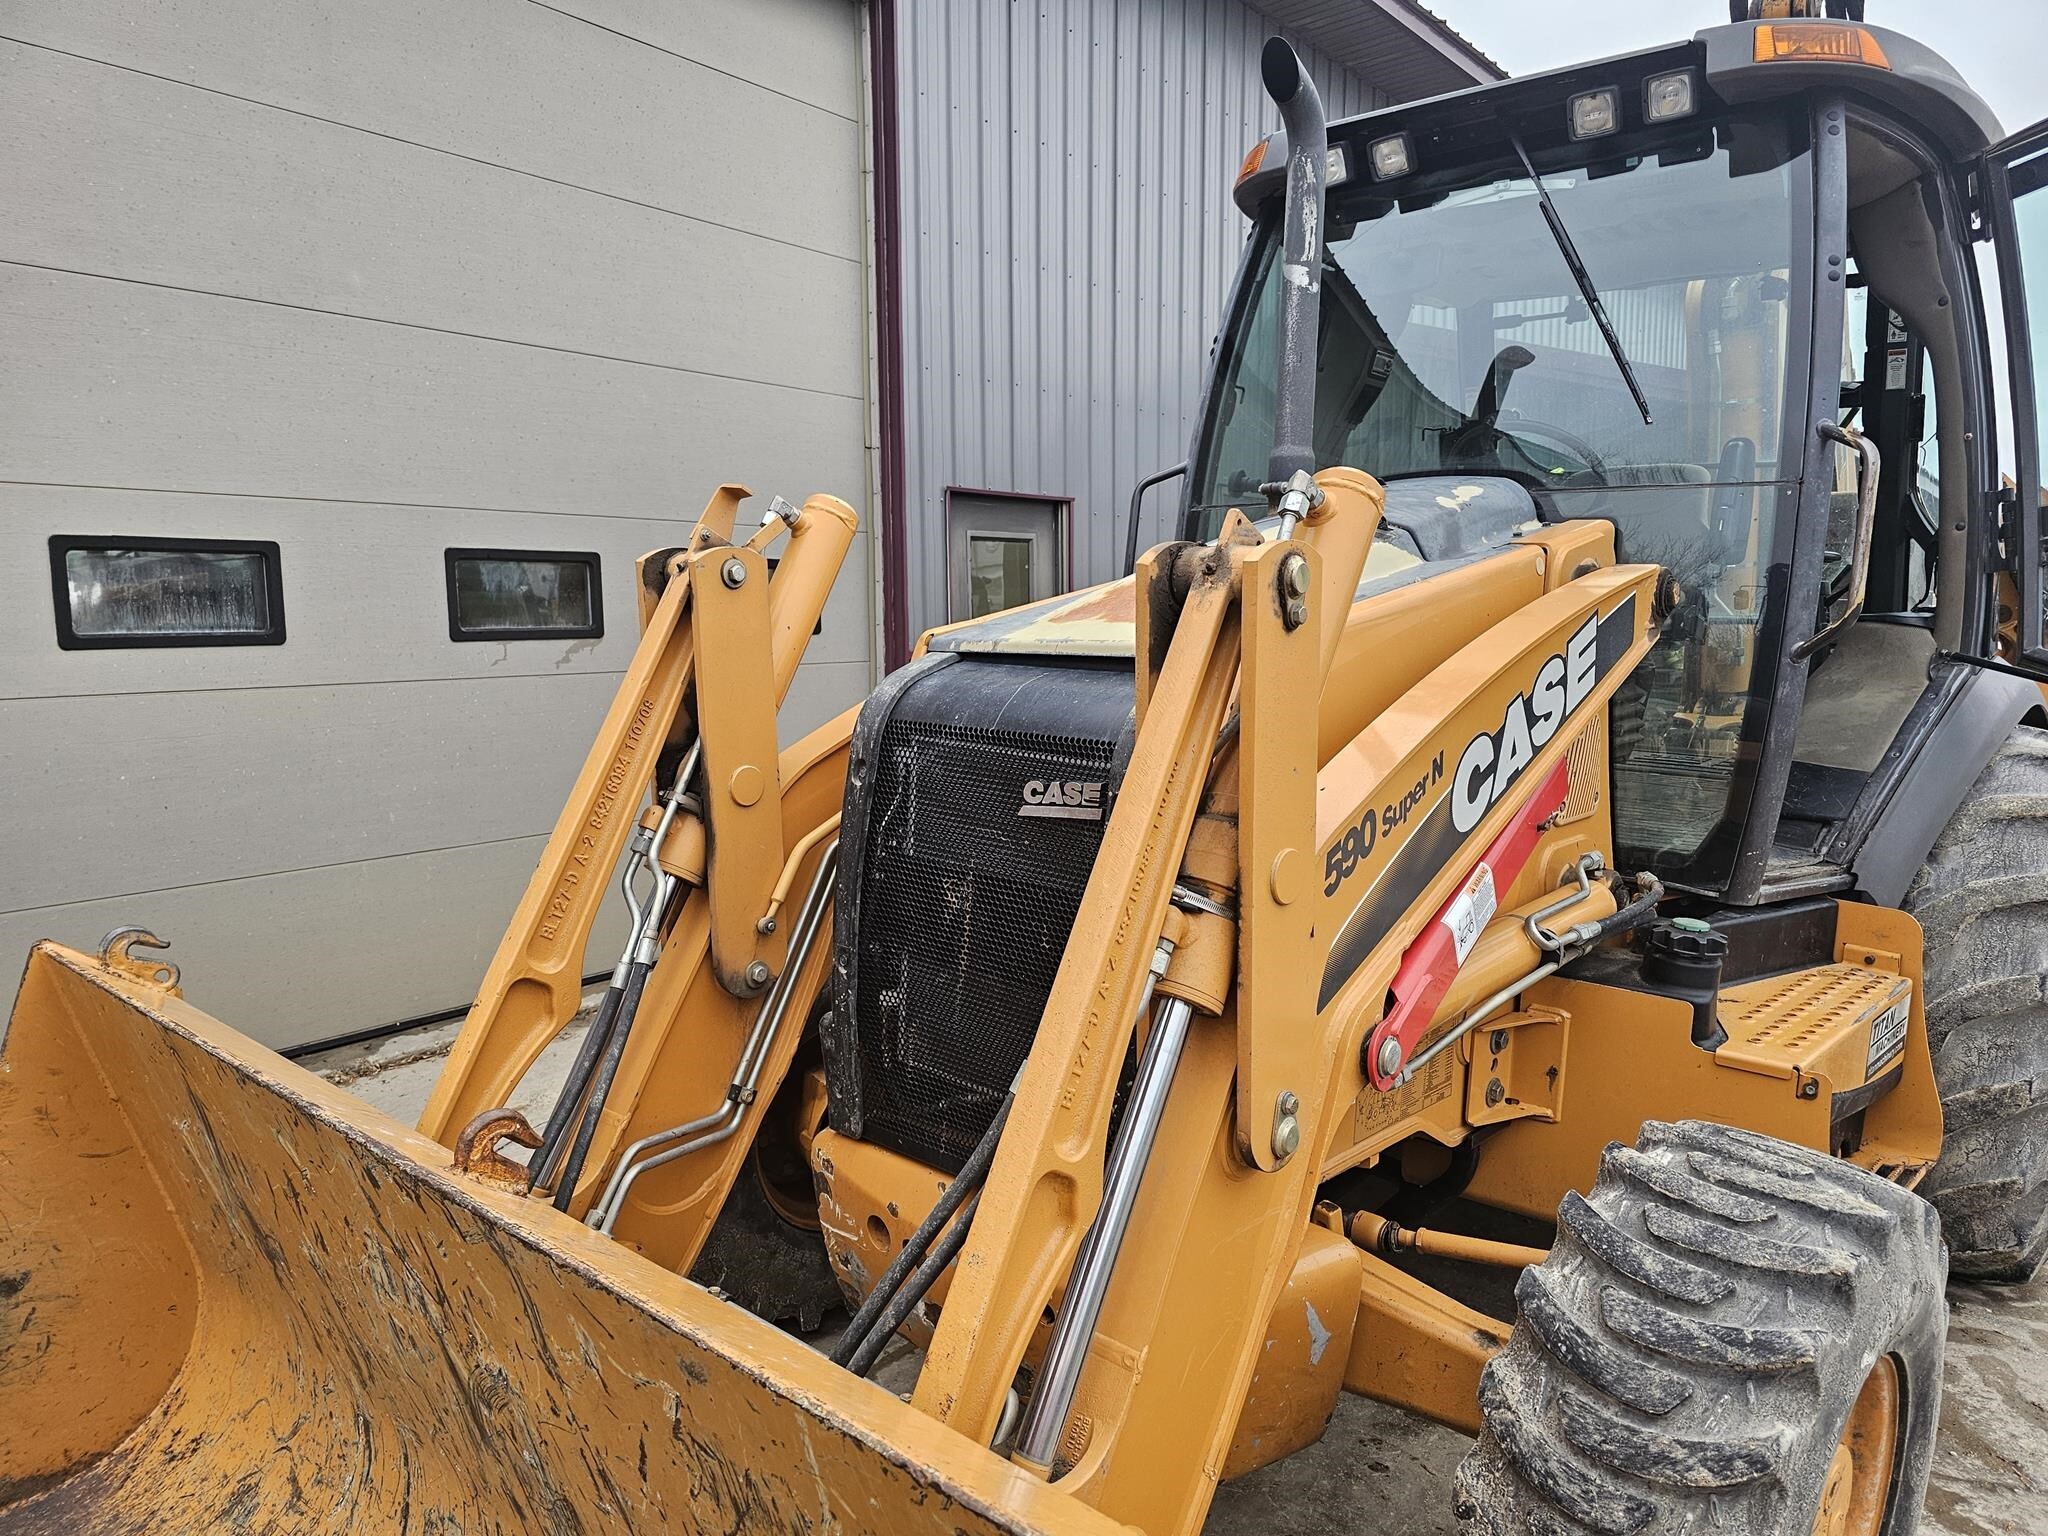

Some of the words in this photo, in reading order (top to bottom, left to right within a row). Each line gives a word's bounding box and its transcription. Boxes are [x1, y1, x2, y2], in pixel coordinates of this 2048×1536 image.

[625, 699, 655, 751] 110708
[1452, 612, 1598, 833] CASE
[1023, 780, 1102, 806] CASE
[1324, 808, 1377, 898] 590
[1382, 772, 1429, 838] Super
[1432, 749, 1444, 787] N
[1872, 1007, 1897, 1042] TITAN
